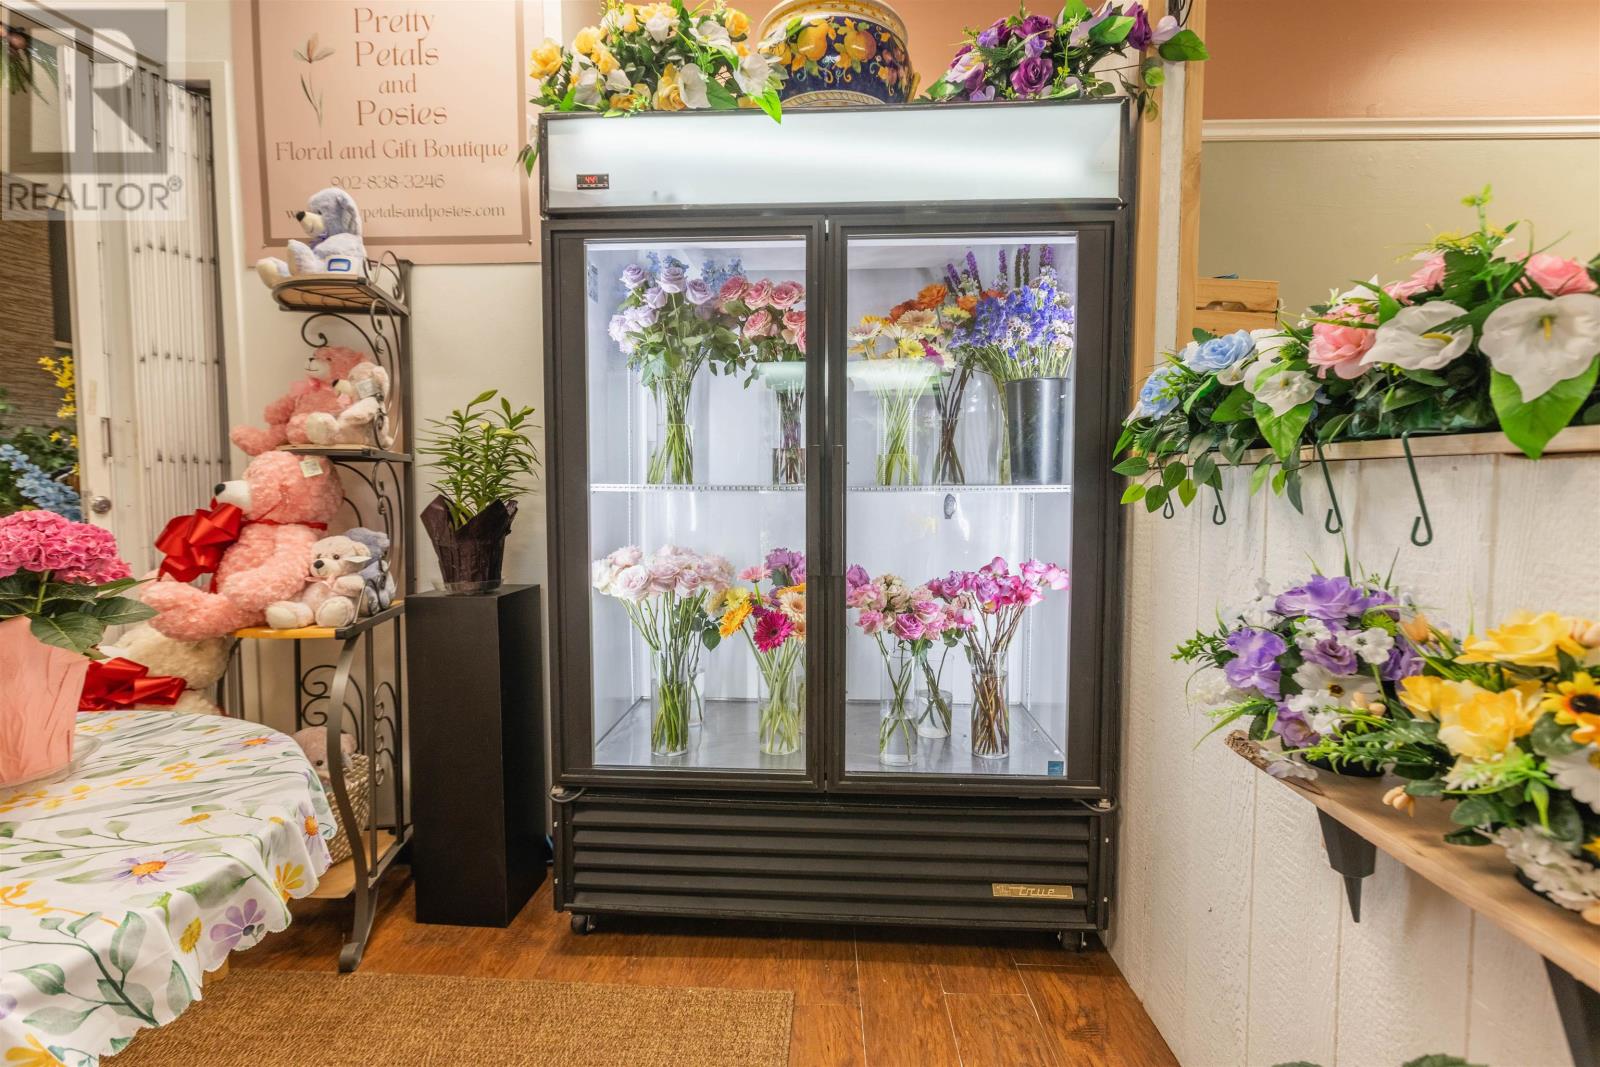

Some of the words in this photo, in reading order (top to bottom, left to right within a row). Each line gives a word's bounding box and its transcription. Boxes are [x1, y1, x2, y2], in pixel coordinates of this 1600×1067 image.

[353, 6, 436, 40] Pretty
[354, 38, 440, 68] Petals
[378, 72, 418, 95] and
[356, 100, 448, 127] Posies
[275, 140, 334, 162] Floral
[339, 139, 377, 161] and
[382, 138, 418, 160] Gift
[423, 138, 509, 163] Boutique
[330, 174, 446, 191] 902-838-3246
